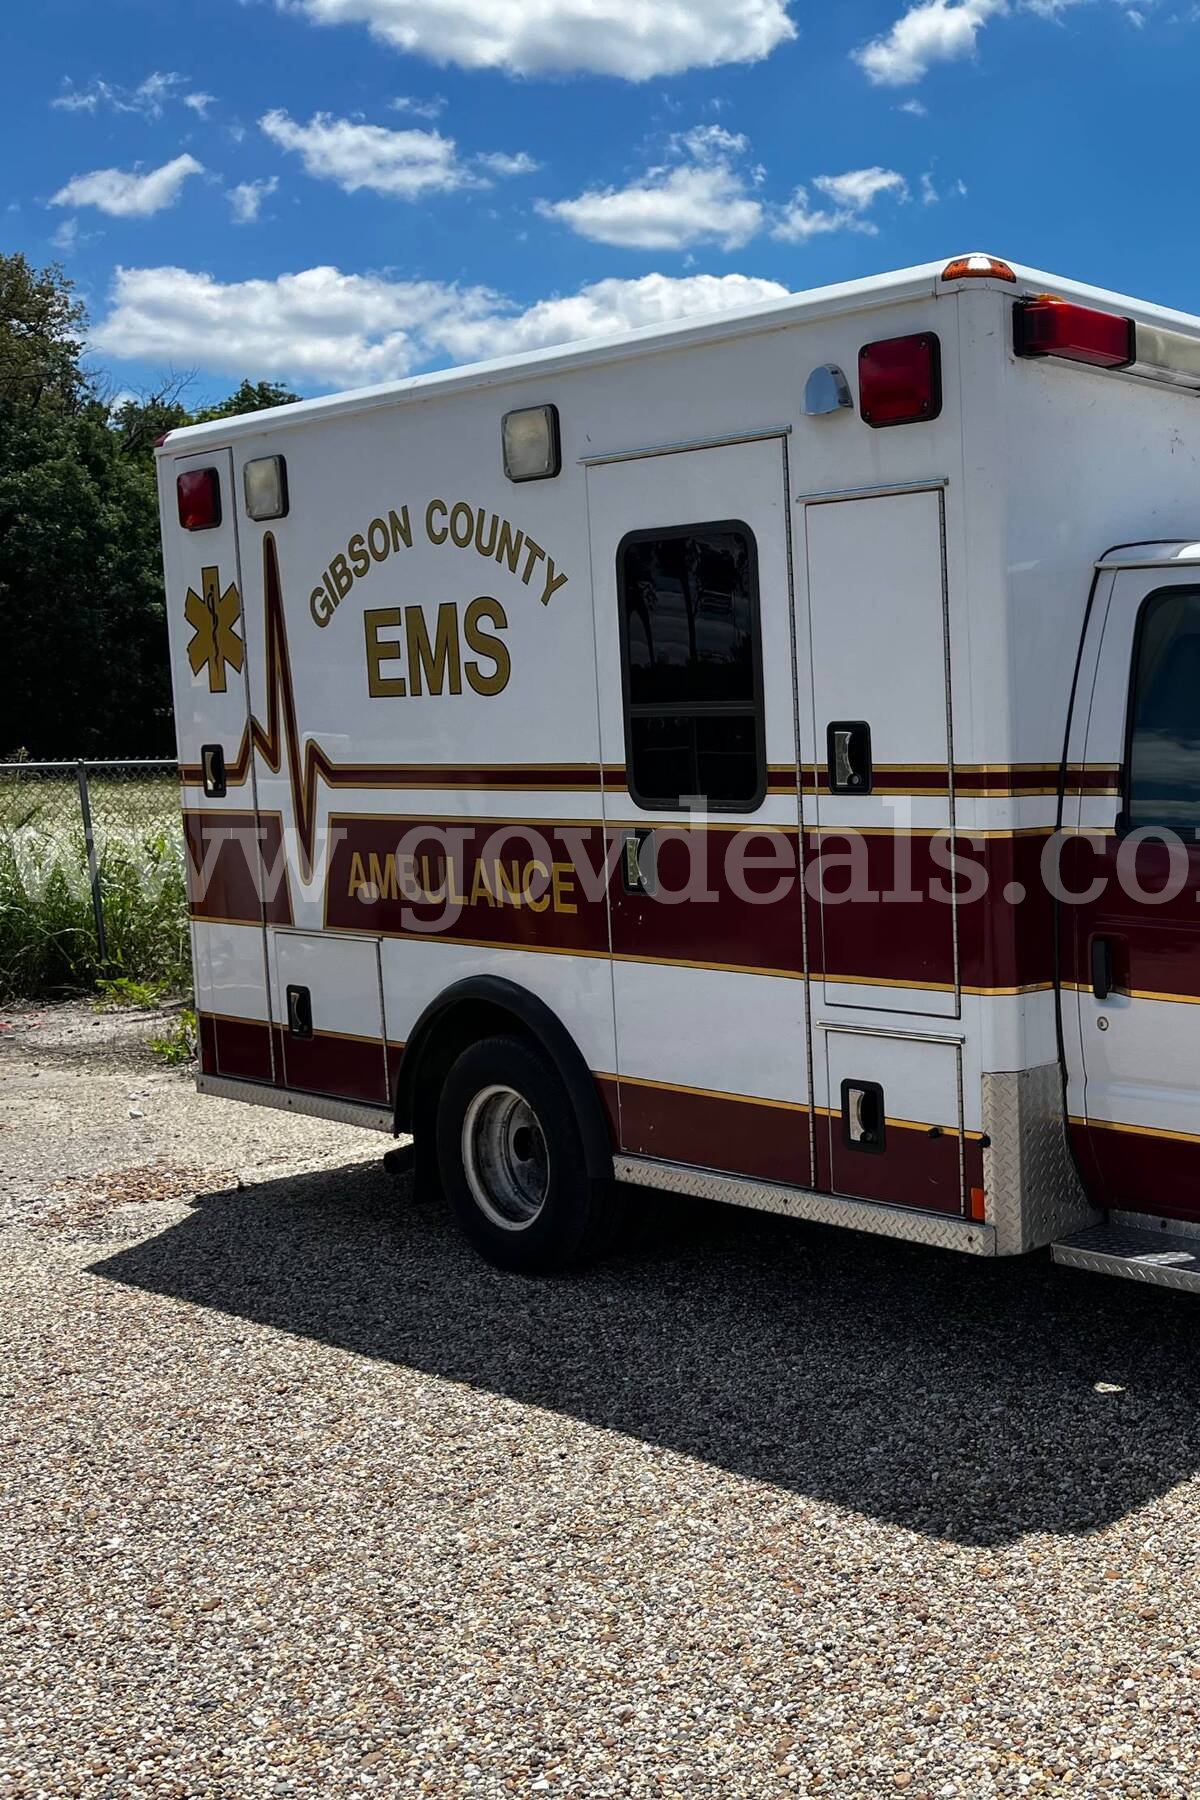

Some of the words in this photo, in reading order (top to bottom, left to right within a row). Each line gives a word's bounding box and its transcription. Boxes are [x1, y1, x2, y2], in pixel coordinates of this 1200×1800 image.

[309, 504, 413, 629] GIBSON
[425, 499, 569, 607] COUNTY
[363, 596, 512, 698] EMS
[347, 851, 579, 915] AMBULANCE
